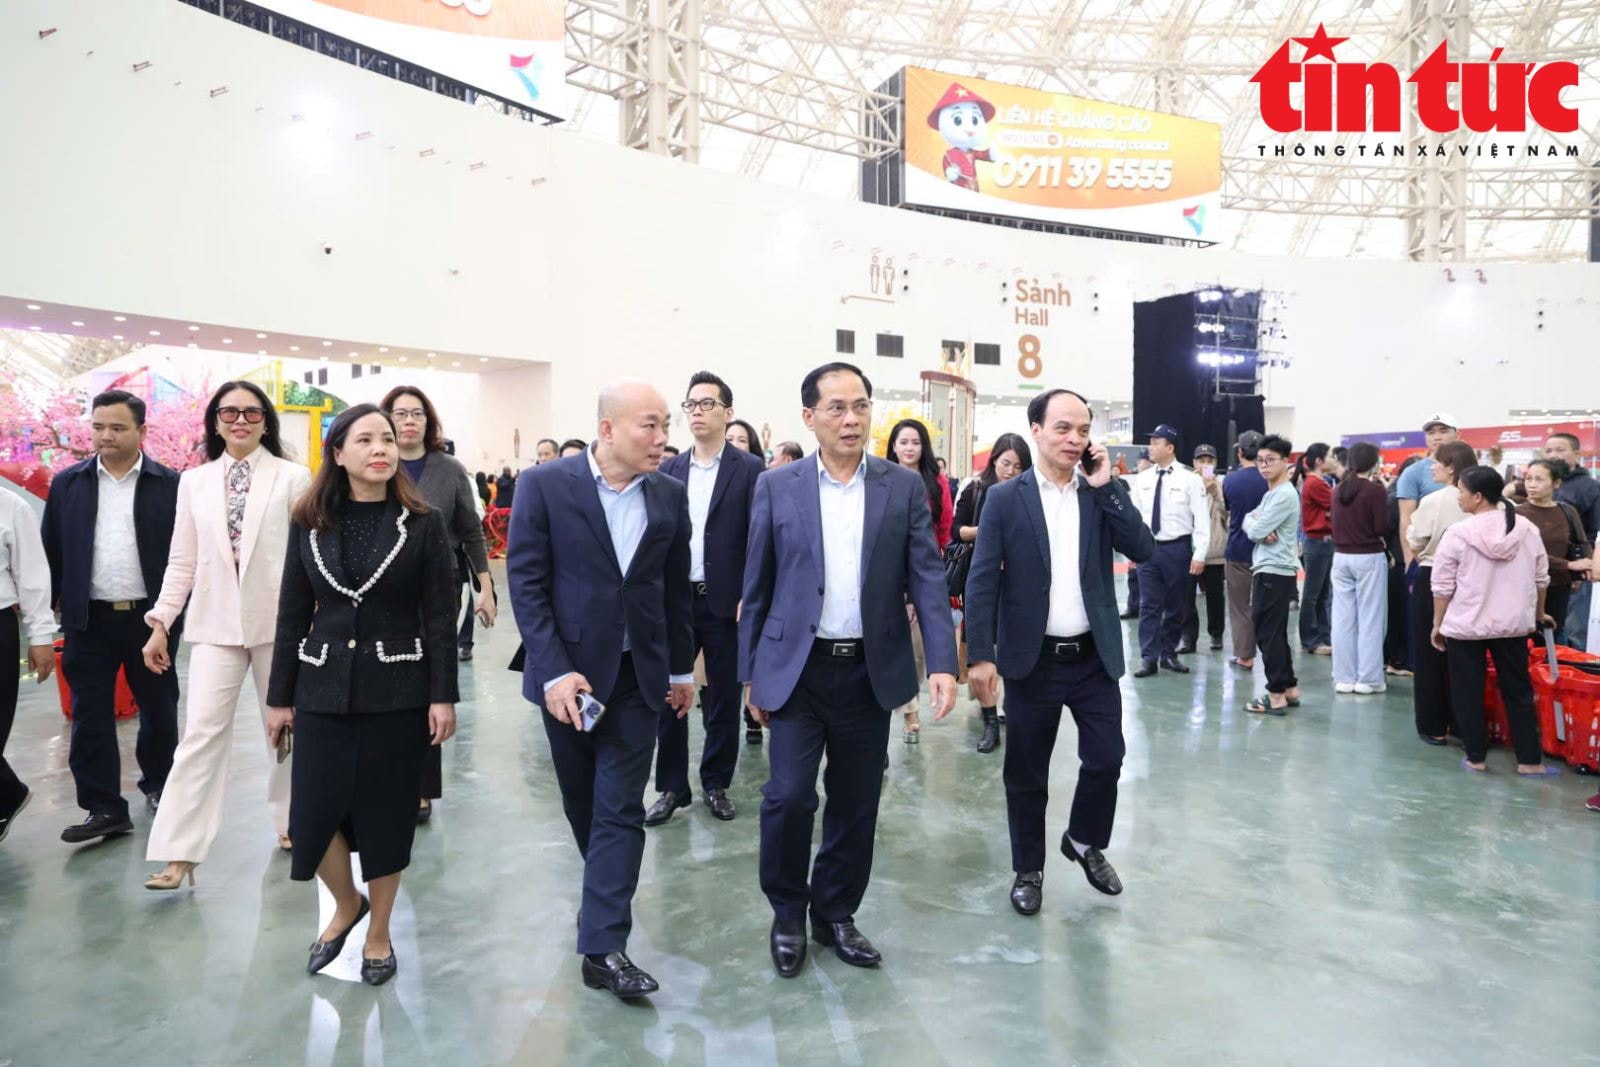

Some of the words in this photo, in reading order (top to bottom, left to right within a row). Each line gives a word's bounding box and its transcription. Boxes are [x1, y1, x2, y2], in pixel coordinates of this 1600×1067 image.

[995, 153, 1063, 188] 0911
[1066, 156, 1104, 188] 39
[1106, 157, 1173, 190] 5555
[1015, 278, 1071, 307] Sảnh
[1015, 306, 1049, 327] Hall
[1017, 334, 1042, 379] 8
